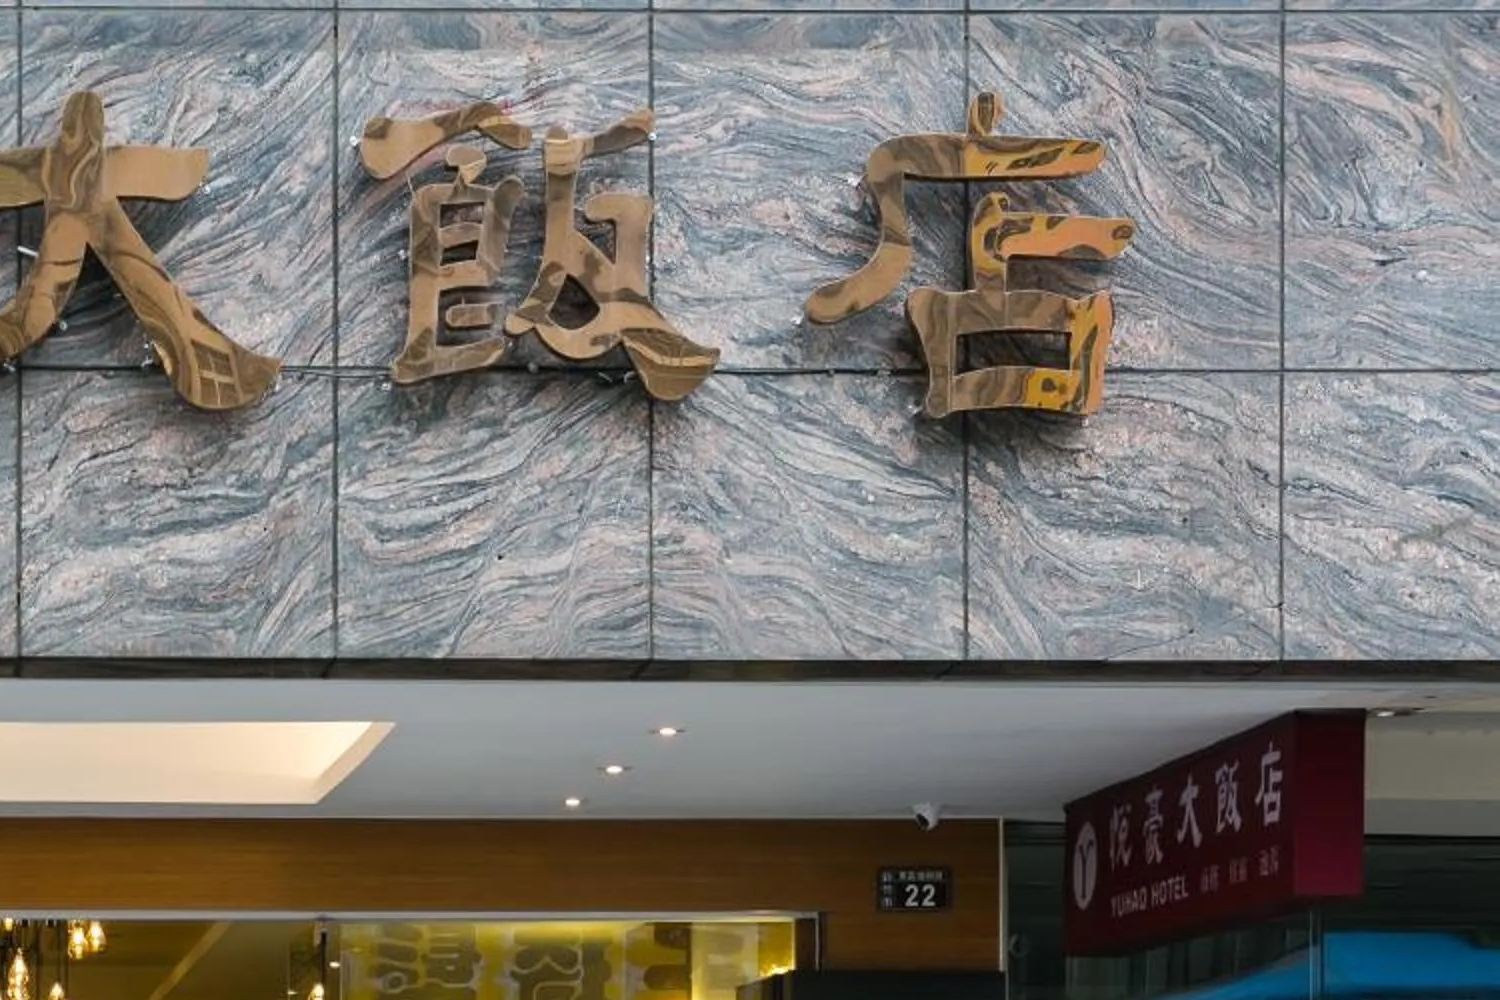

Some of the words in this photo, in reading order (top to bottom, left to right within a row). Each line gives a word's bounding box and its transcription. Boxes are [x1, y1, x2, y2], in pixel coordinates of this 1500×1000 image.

[904, 884, 937, 908] 22
[1110, 886, 1148, 918] YUHAO
[1151, 874, 1190, 905] HOTEL
